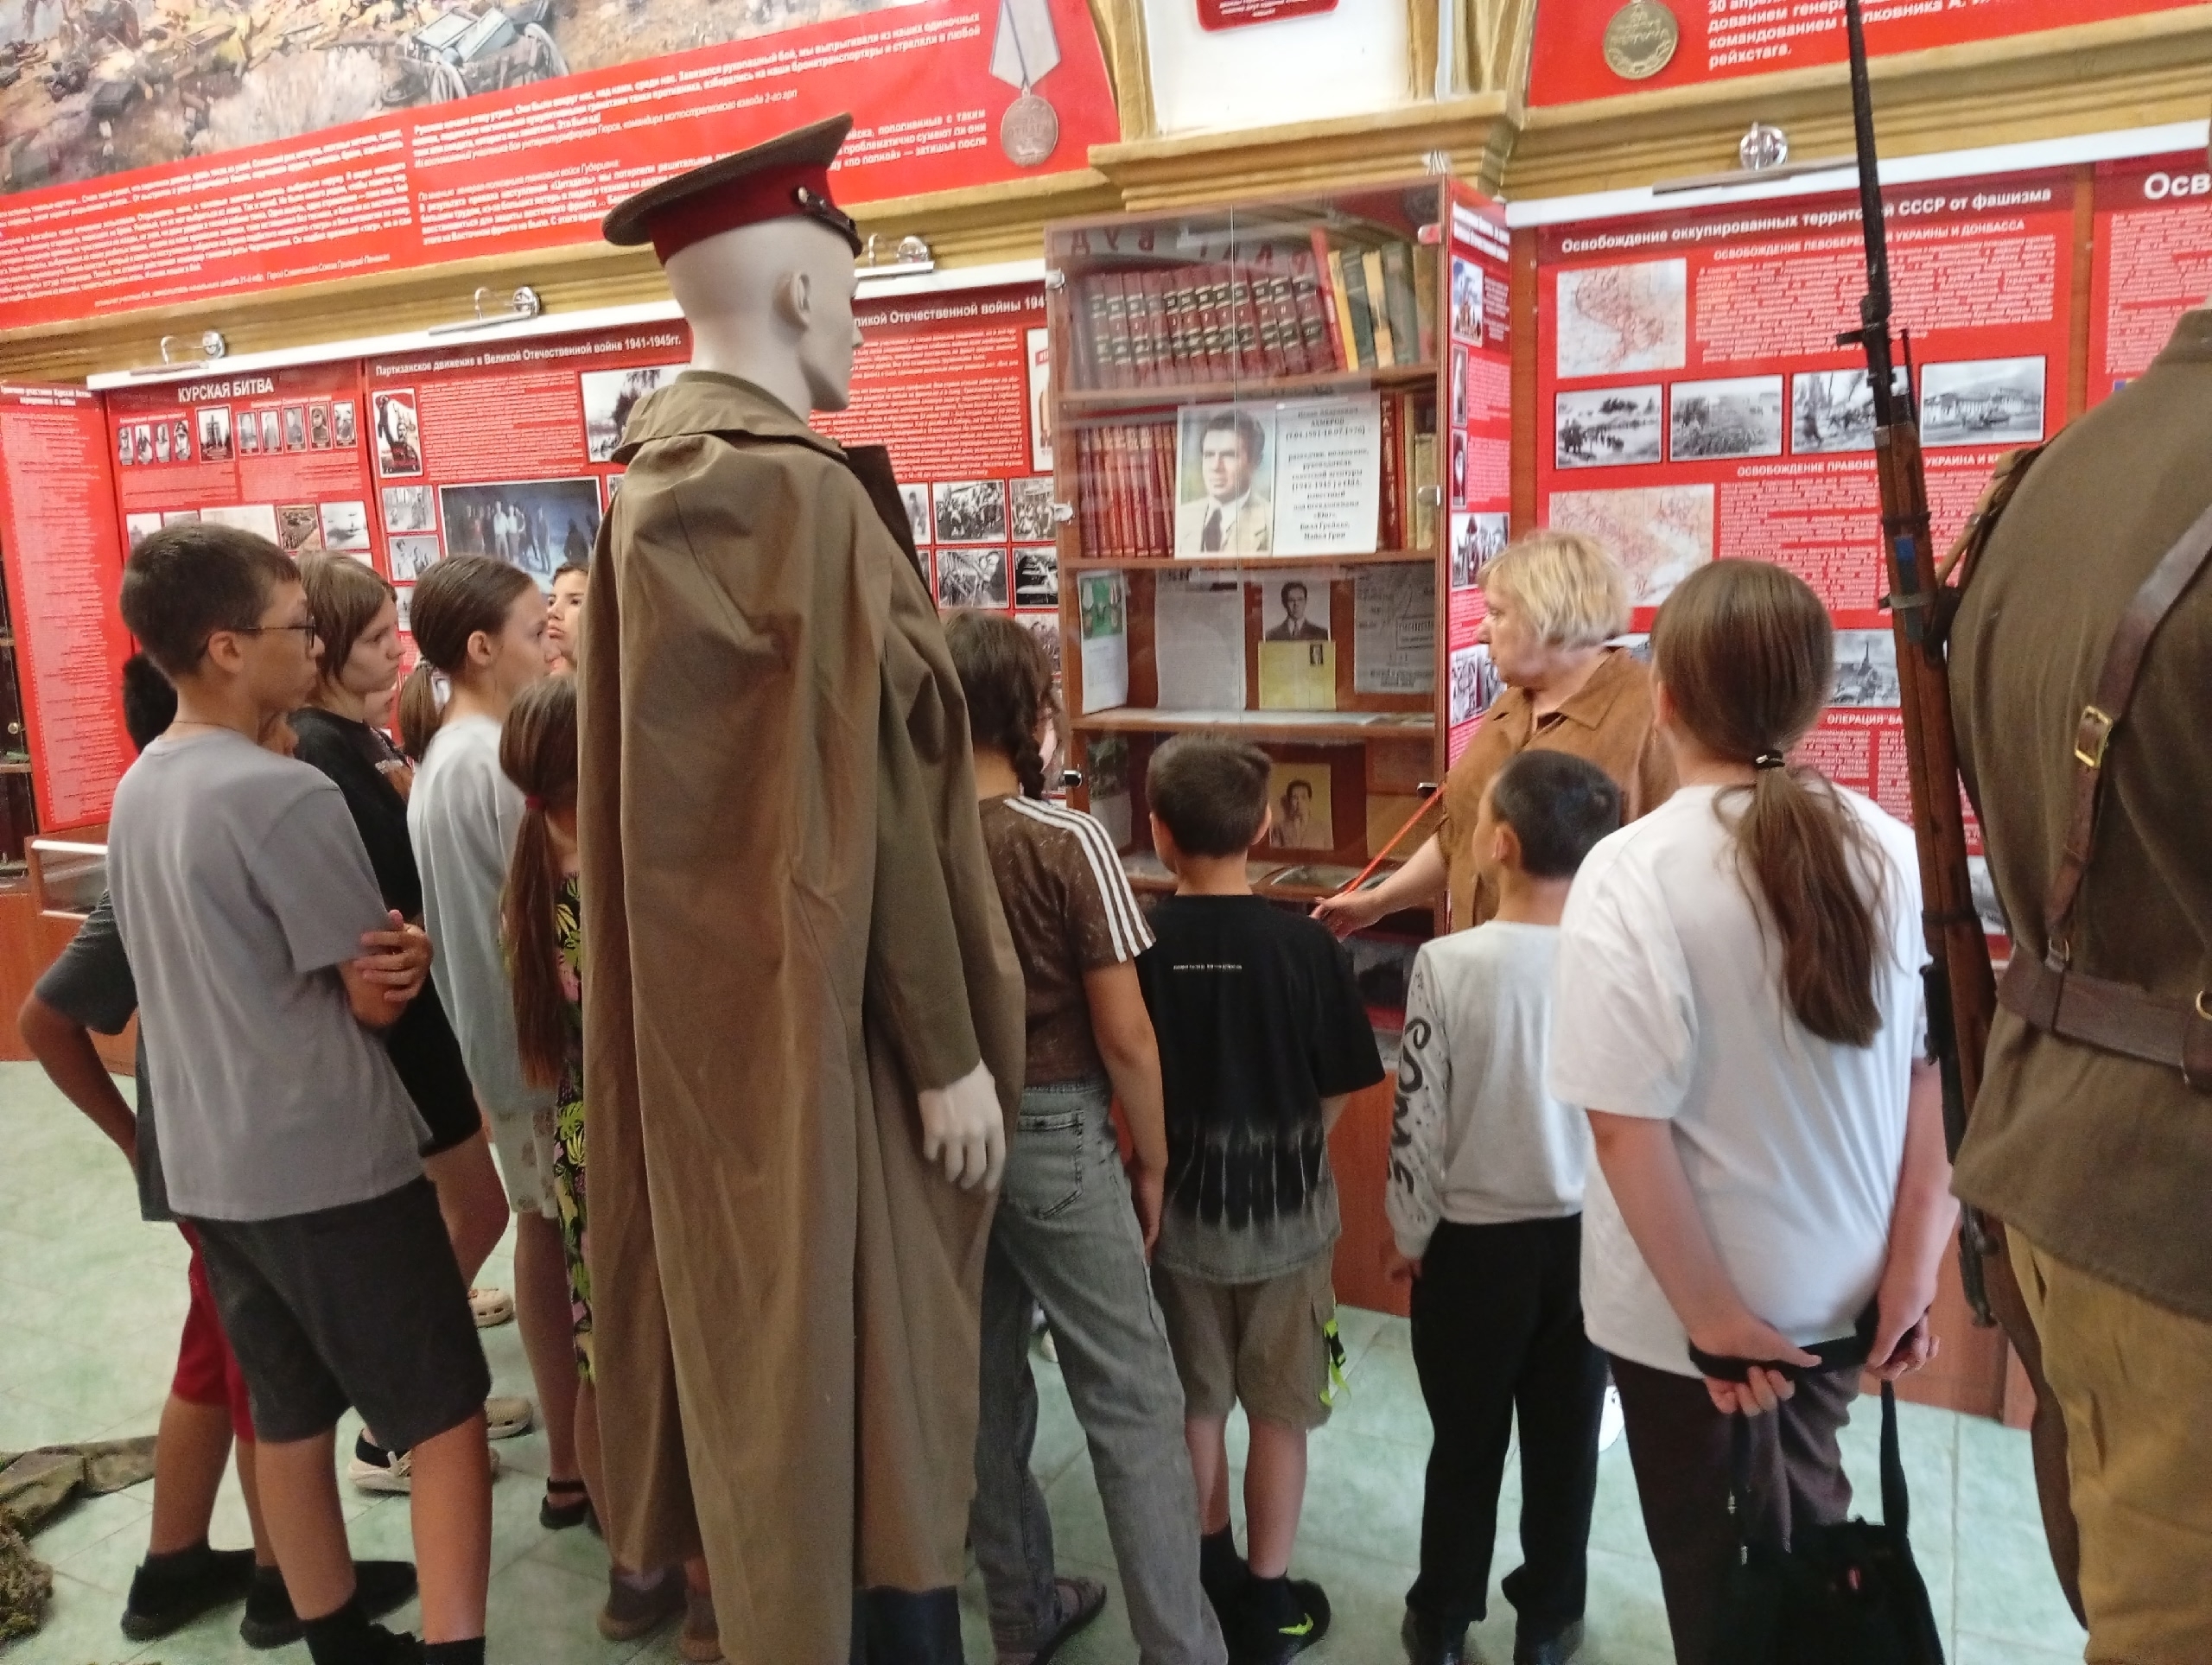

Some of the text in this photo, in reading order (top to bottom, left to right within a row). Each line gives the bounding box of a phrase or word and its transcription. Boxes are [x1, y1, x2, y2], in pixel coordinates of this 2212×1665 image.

[816, 33, 878, 53] выпрыгивали
[880, 29, 890, 41] из
[893, 23, 922, 38] наших
[925, 13, 978, 31] одиночных
[1708, 7, 1788, 33] дованием
[1708, 18, 1837, 50] командованием
[1841, 0, 1942, 27] плковника
[893, 35, 936, 51] стреляли
[947, 26, 979, 41] любой
[844, 121, 986, 155] проблематично сумеют ли они
[879, 116, 943, 135] пополненные
[957, 108, 985, 123] таким
[958, 135, 986, 149] после
[1561, 187, 2051, 252] Освобождение оккупированных территой СССР от фашизма
[1713, 243, 1801, 260] ОСВОБОЖДЕНИЕ
[1896, 226, 1948, 241] УКРАИНЫ
[1951, 225, 1959, 237] И
[1961, 219, 2024, 236] ДОНБАССА
[855, 294, 1046, 328] ликой Отечественной войны 194
[376, 361, 431, 377] Партизанское
[433, 358, 474, 372] движение
[484, 351, 522, 365] Великой
[524, 342, 593, 360] Отечественной
[594, 339, 623, 354] войне
[625, 333, 681, 350] 1941-1945гг.
[178, 383, 231, 402] КУРСКАЯ
[233, 378, 274, 396] БИТВА
[1737, 462, 1824, 477] ОСВОБОЖДЕНИЕ
[1977, 454, 1986, 465] И
